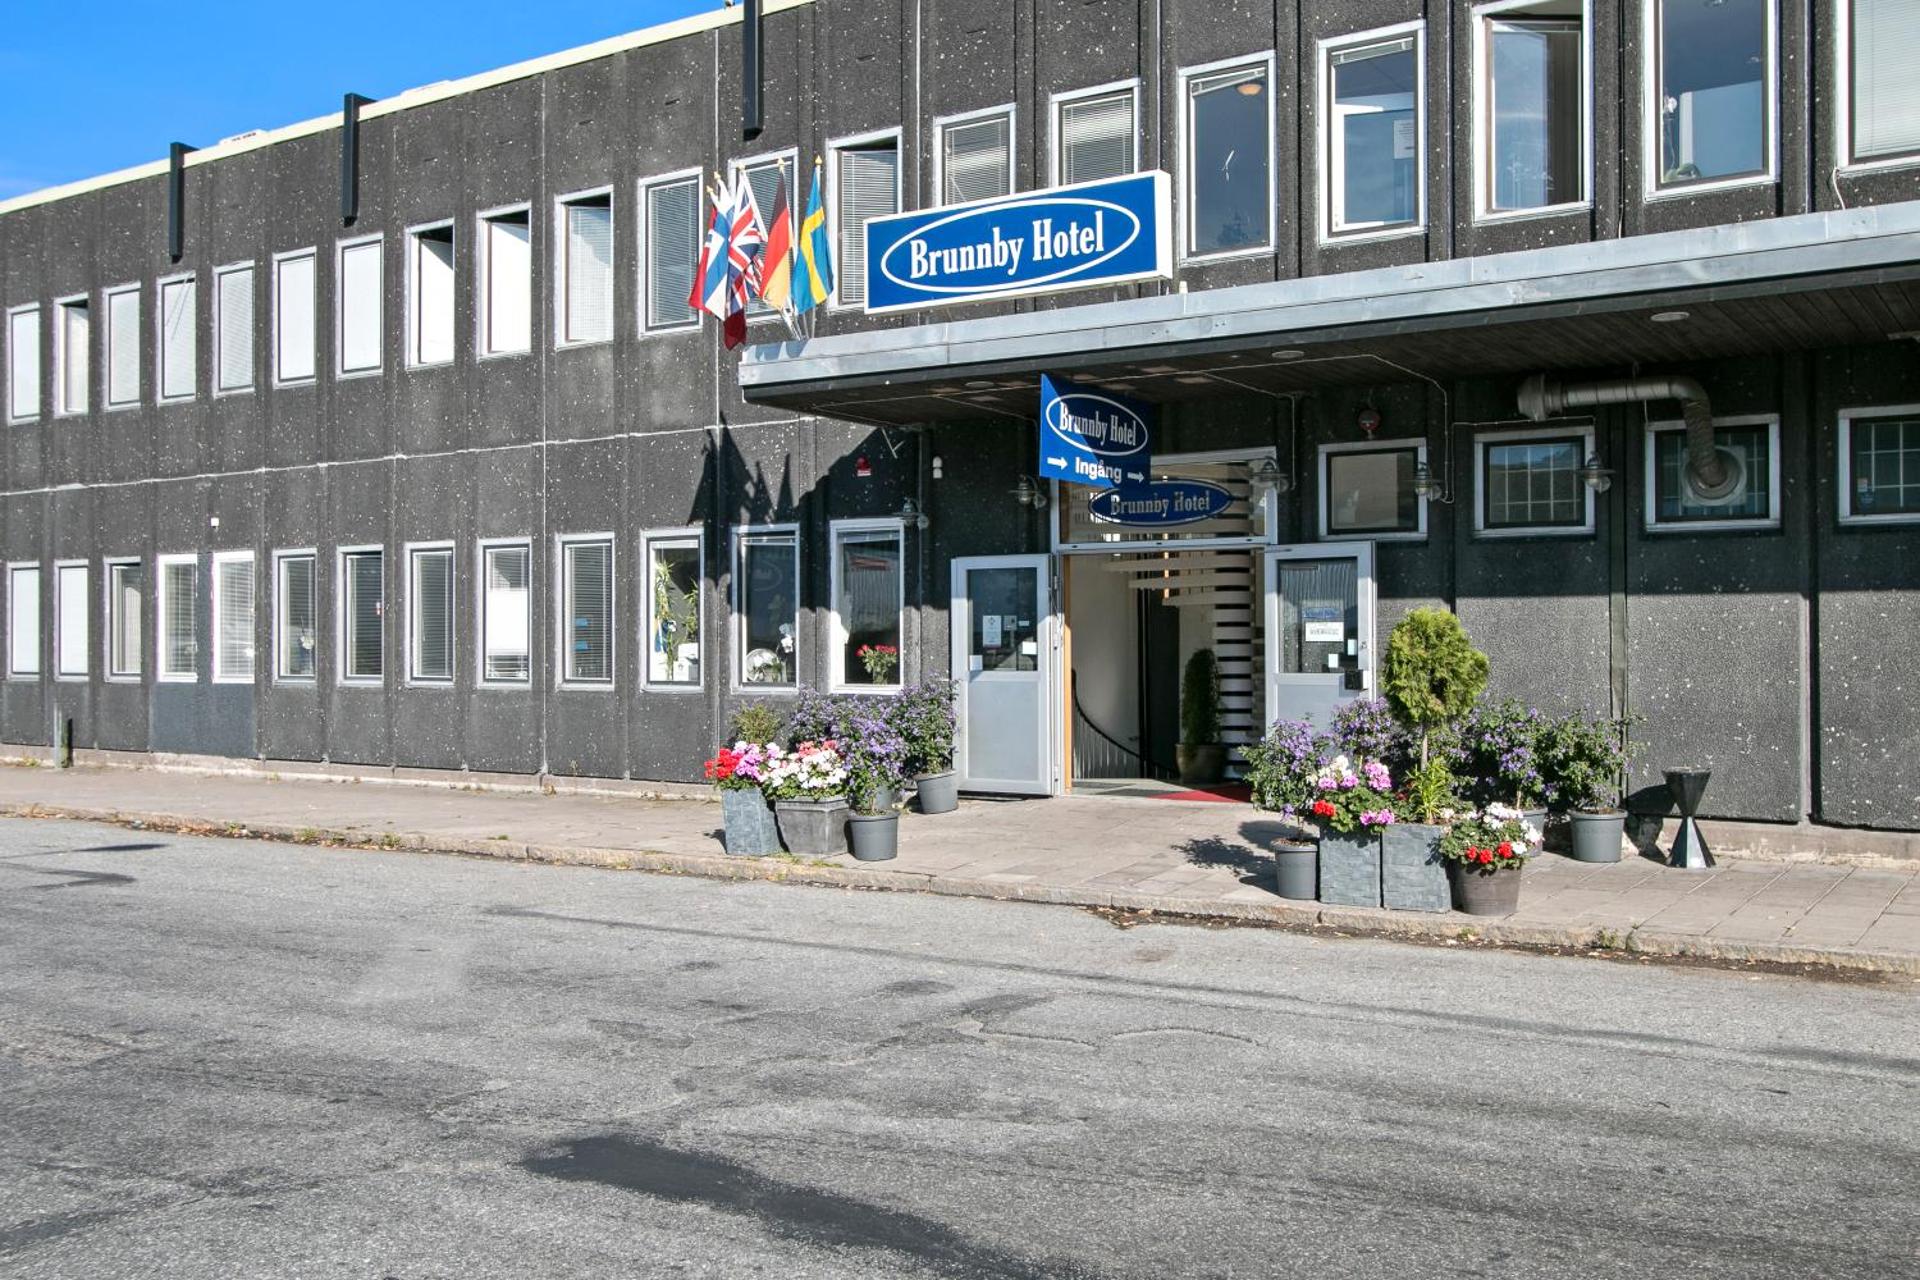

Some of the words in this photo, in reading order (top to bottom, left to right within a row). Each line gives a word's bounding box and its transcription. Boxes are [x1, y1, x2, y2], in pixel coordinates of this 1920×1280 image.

[910, 227, 1024, 278] Brunnby
[1032, 210, 1104, 261] Hotel
[1059, 401, 1107, 445] Brunnby
[1110, 414, 1137, 446] Hotel
[1075, 456, 1122, 484] Ingång
[1110, 494, 1169, 517] Brunnby
[1173, 491, 1210, 513] Hotel
